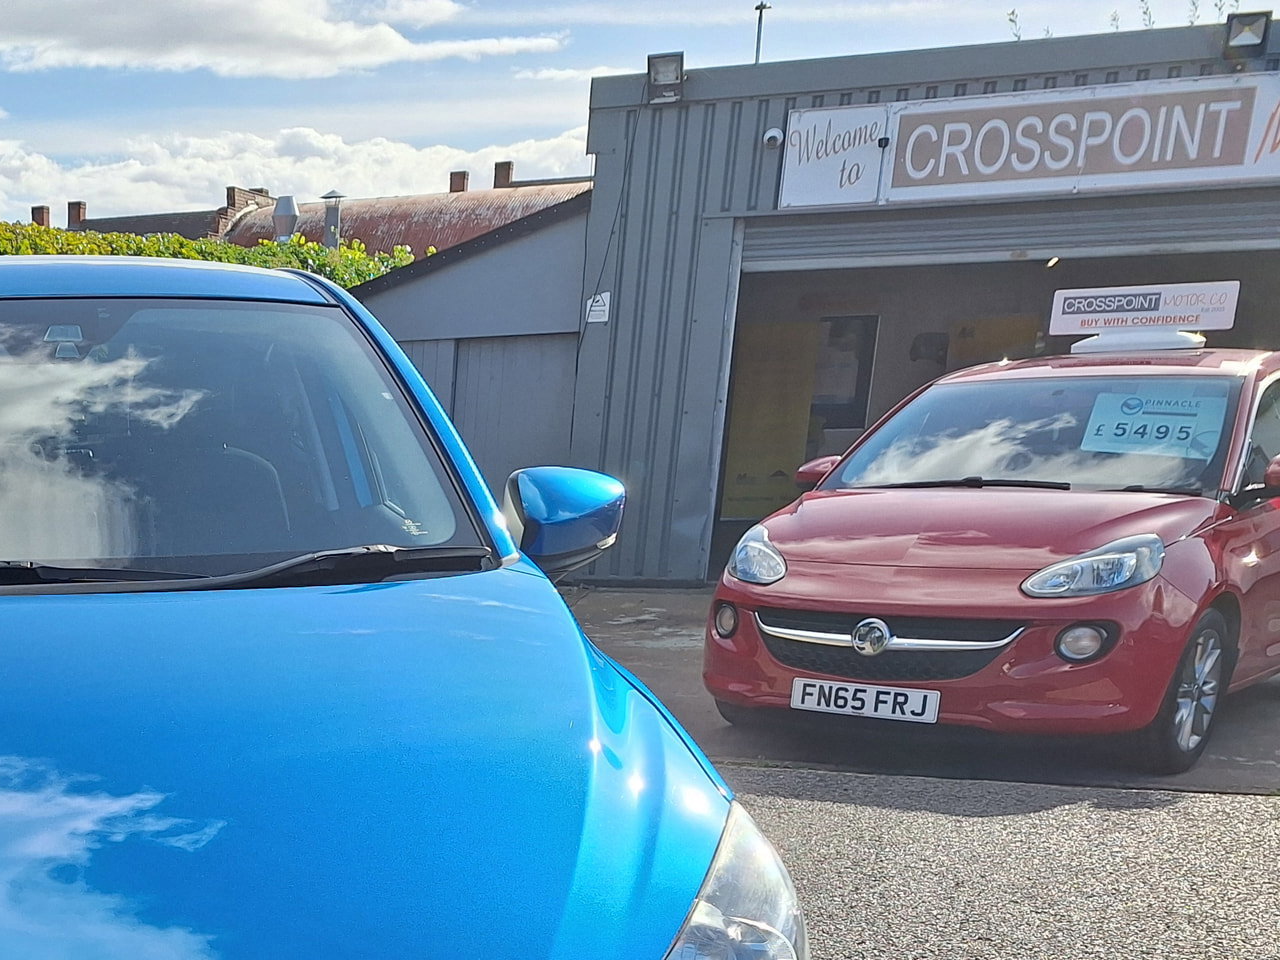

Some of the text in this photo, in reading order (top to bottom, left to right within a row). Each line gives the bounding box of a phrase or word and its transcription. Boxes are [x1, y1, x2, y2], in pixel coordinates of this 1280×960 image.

[790, 118, 881, 166] Welcome
[905, 100, 1242, 180] CROSSPOINT
[839, 159, 865, 189] to
[1063, 292, 1228, 312] CROSSPOINT MOTOR CO
[1080, 314, 1200, 328] BUY WITH CONFIDENCE
[1144, 399, 1202, 408] PINNACLE
[801, 683, 928, 717] FN65 FRJ
